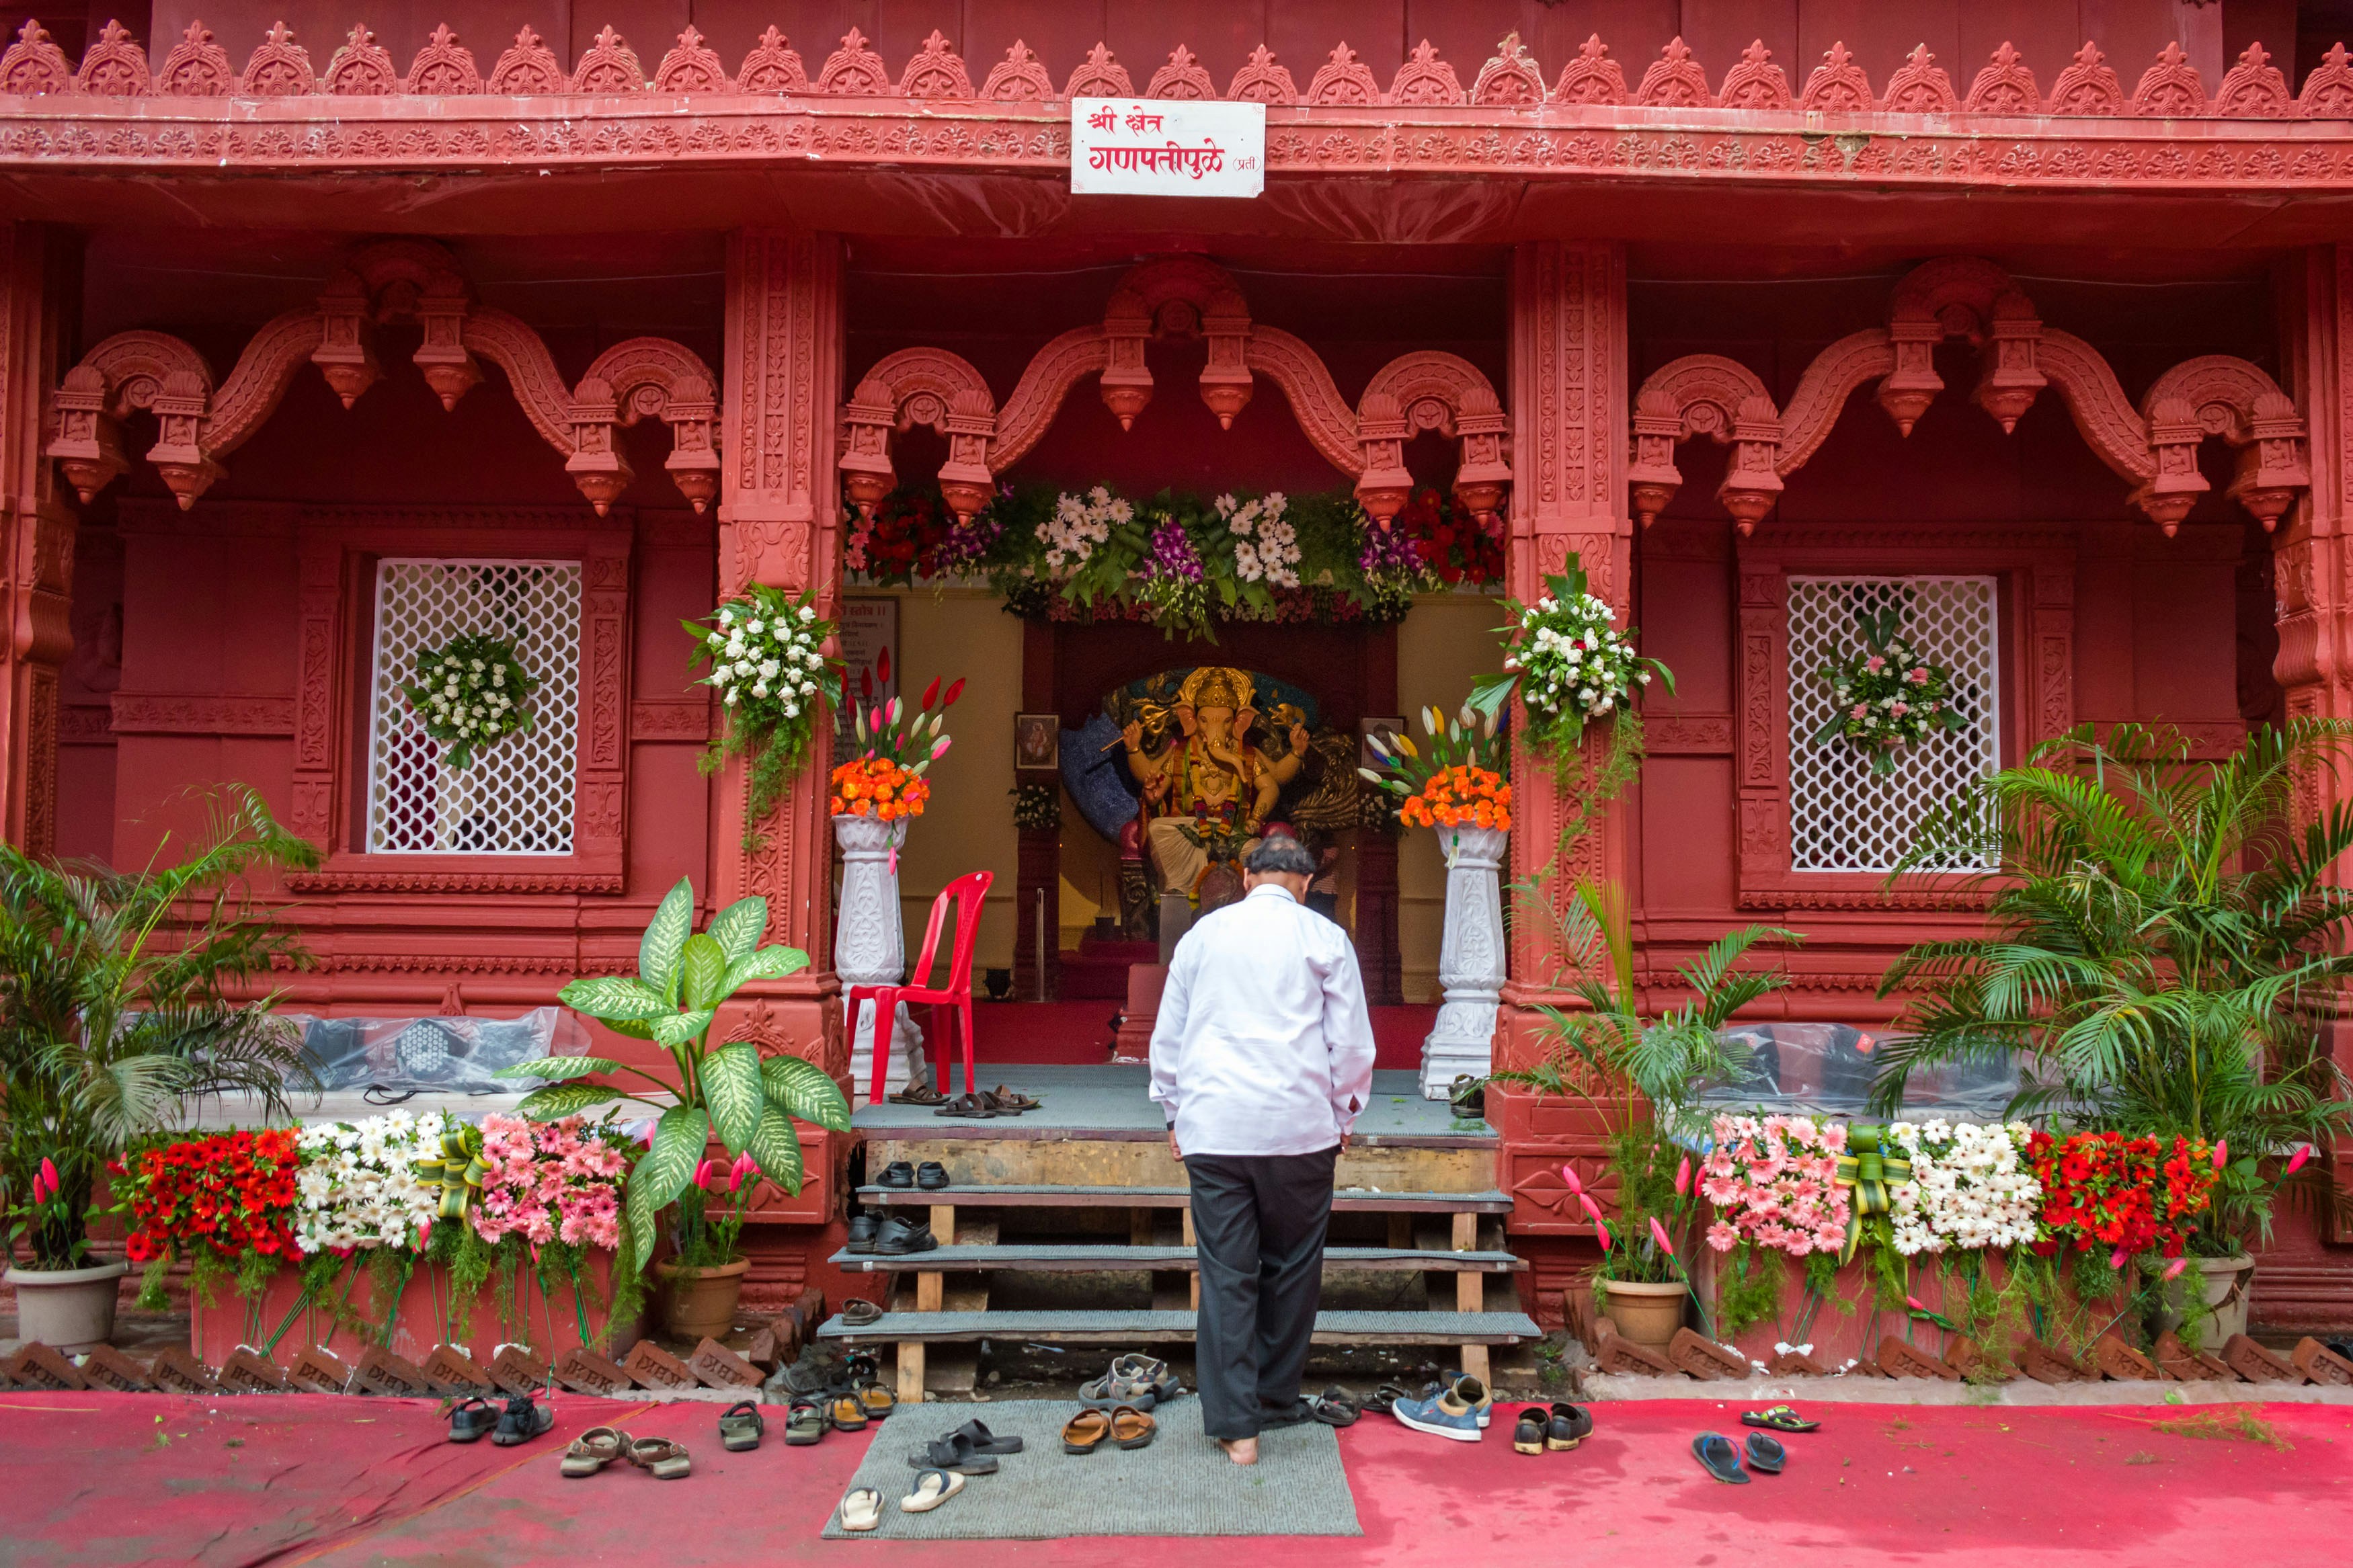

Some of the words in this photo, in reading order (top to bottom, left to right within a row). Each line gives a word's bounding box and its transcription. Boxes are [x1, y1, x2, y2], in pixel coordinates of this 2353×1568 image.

[1087, 105, 1117, 134] श्री
[1125, 105, 1164, 136] क्षेत्र
[1089, 137, 1225, 179] गणपतीपुळे
